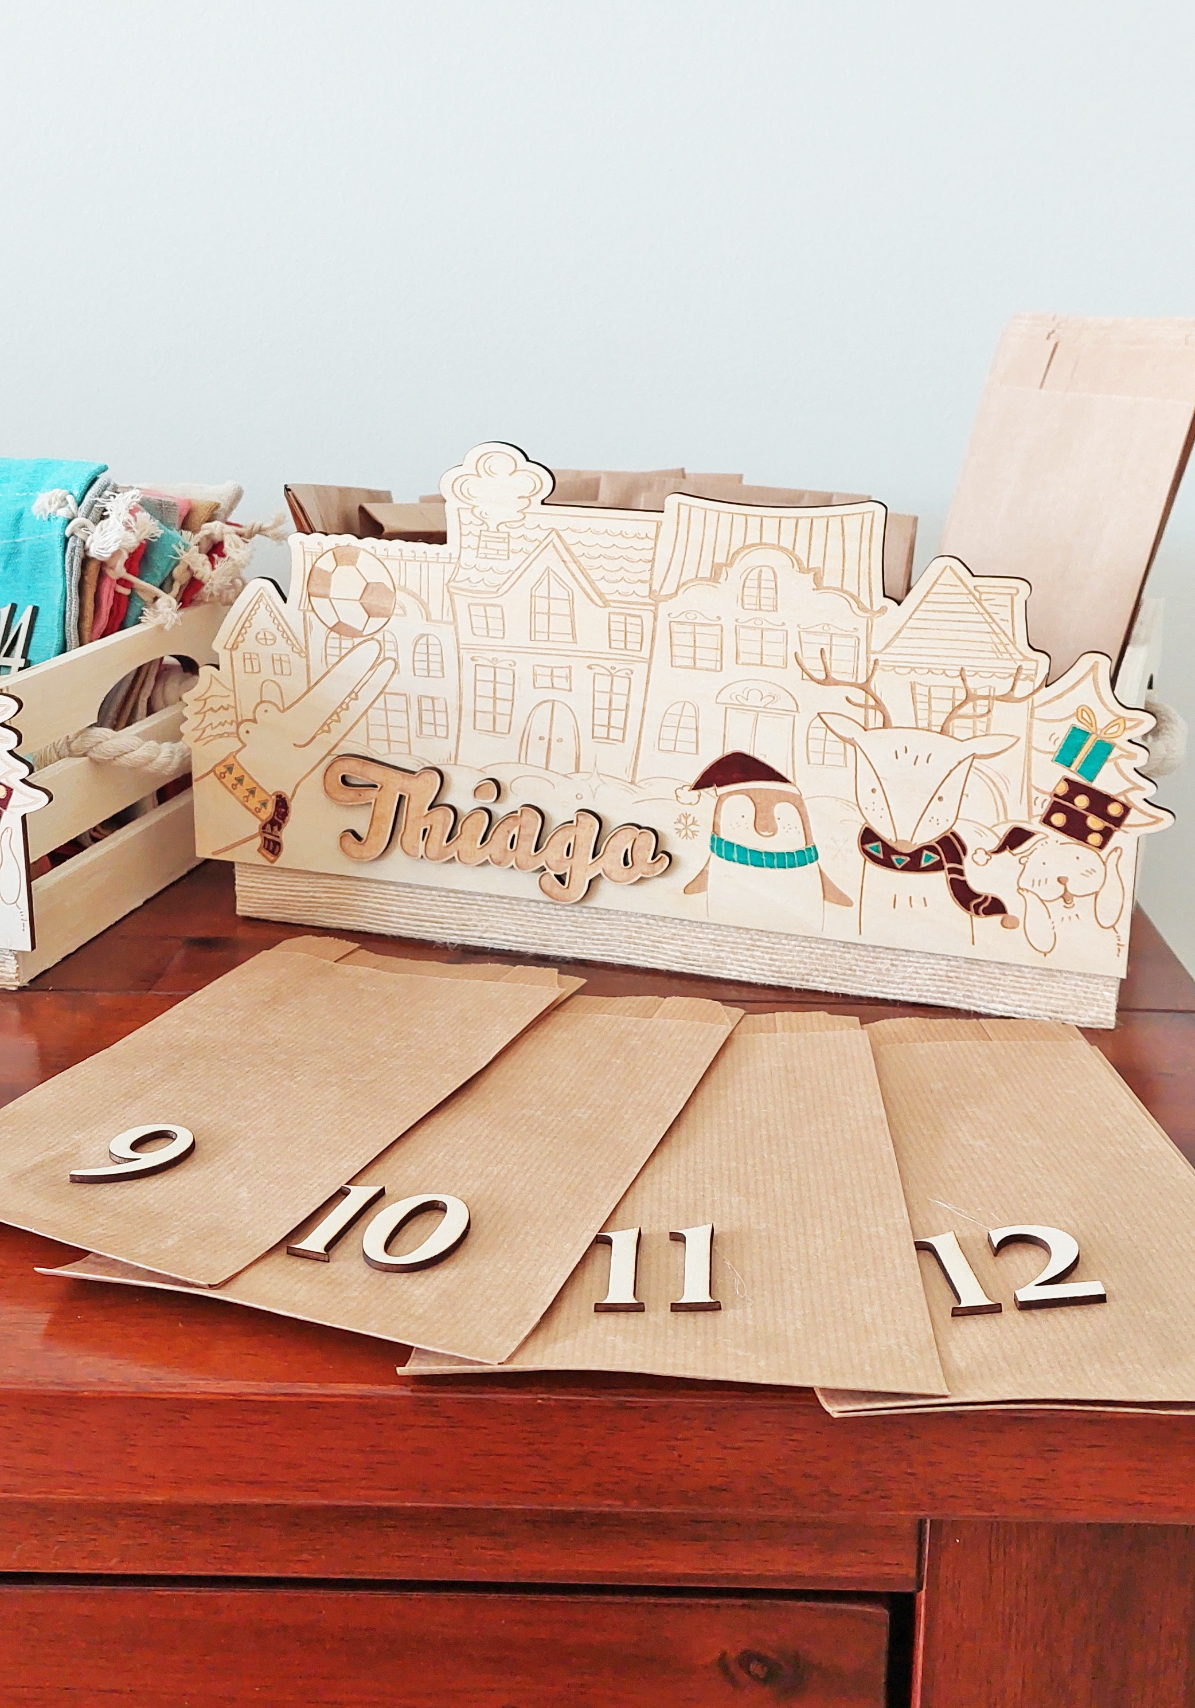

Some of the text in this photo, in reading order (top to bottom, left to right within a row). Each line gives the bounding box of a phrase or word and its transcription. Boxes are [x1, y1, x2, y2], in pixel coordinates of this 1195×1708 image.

[69, 1123, 195, 1183] 9
[286, 1184, 471, 1272] 10
[593, 1223, 721, 1312] 11
[915, 1225, 1107, 1317] 12
